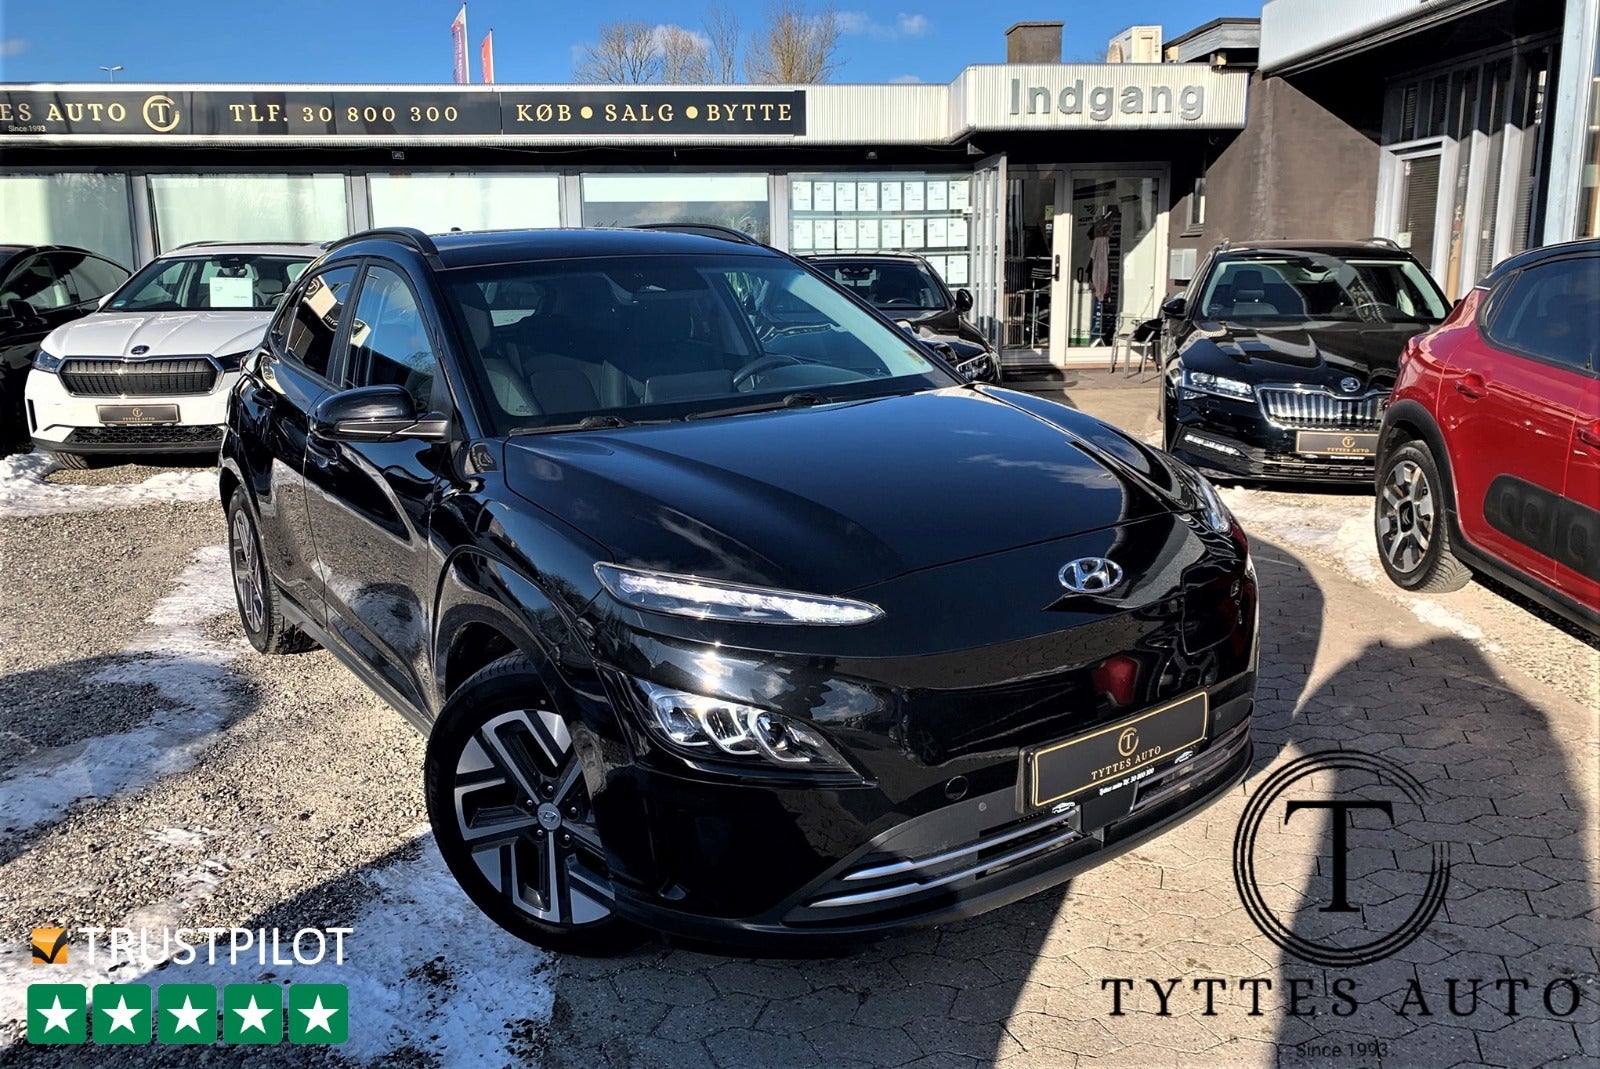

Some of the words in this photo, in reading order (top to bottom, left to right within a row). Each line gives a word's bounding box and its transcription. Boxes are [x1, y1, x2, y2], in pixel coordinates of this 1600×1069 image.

[1009, 78, 1205, 121] Indgang
[46, 103, 126, 122] AUTO
[230, 104, 288, 122] TLF.
[302, 106, 332, 122] 30
[347, 106, 395, 122] 800
[410, 106, 458, 122] 300
[516, 103, 572, 122] KØB
[604, 104, 674, 122] SALG
[706, 103, 792, 122] BYTTE
[1091, 758, 1131, 780] TYTTES
[1135, 745, 1161, 764] AUTO
